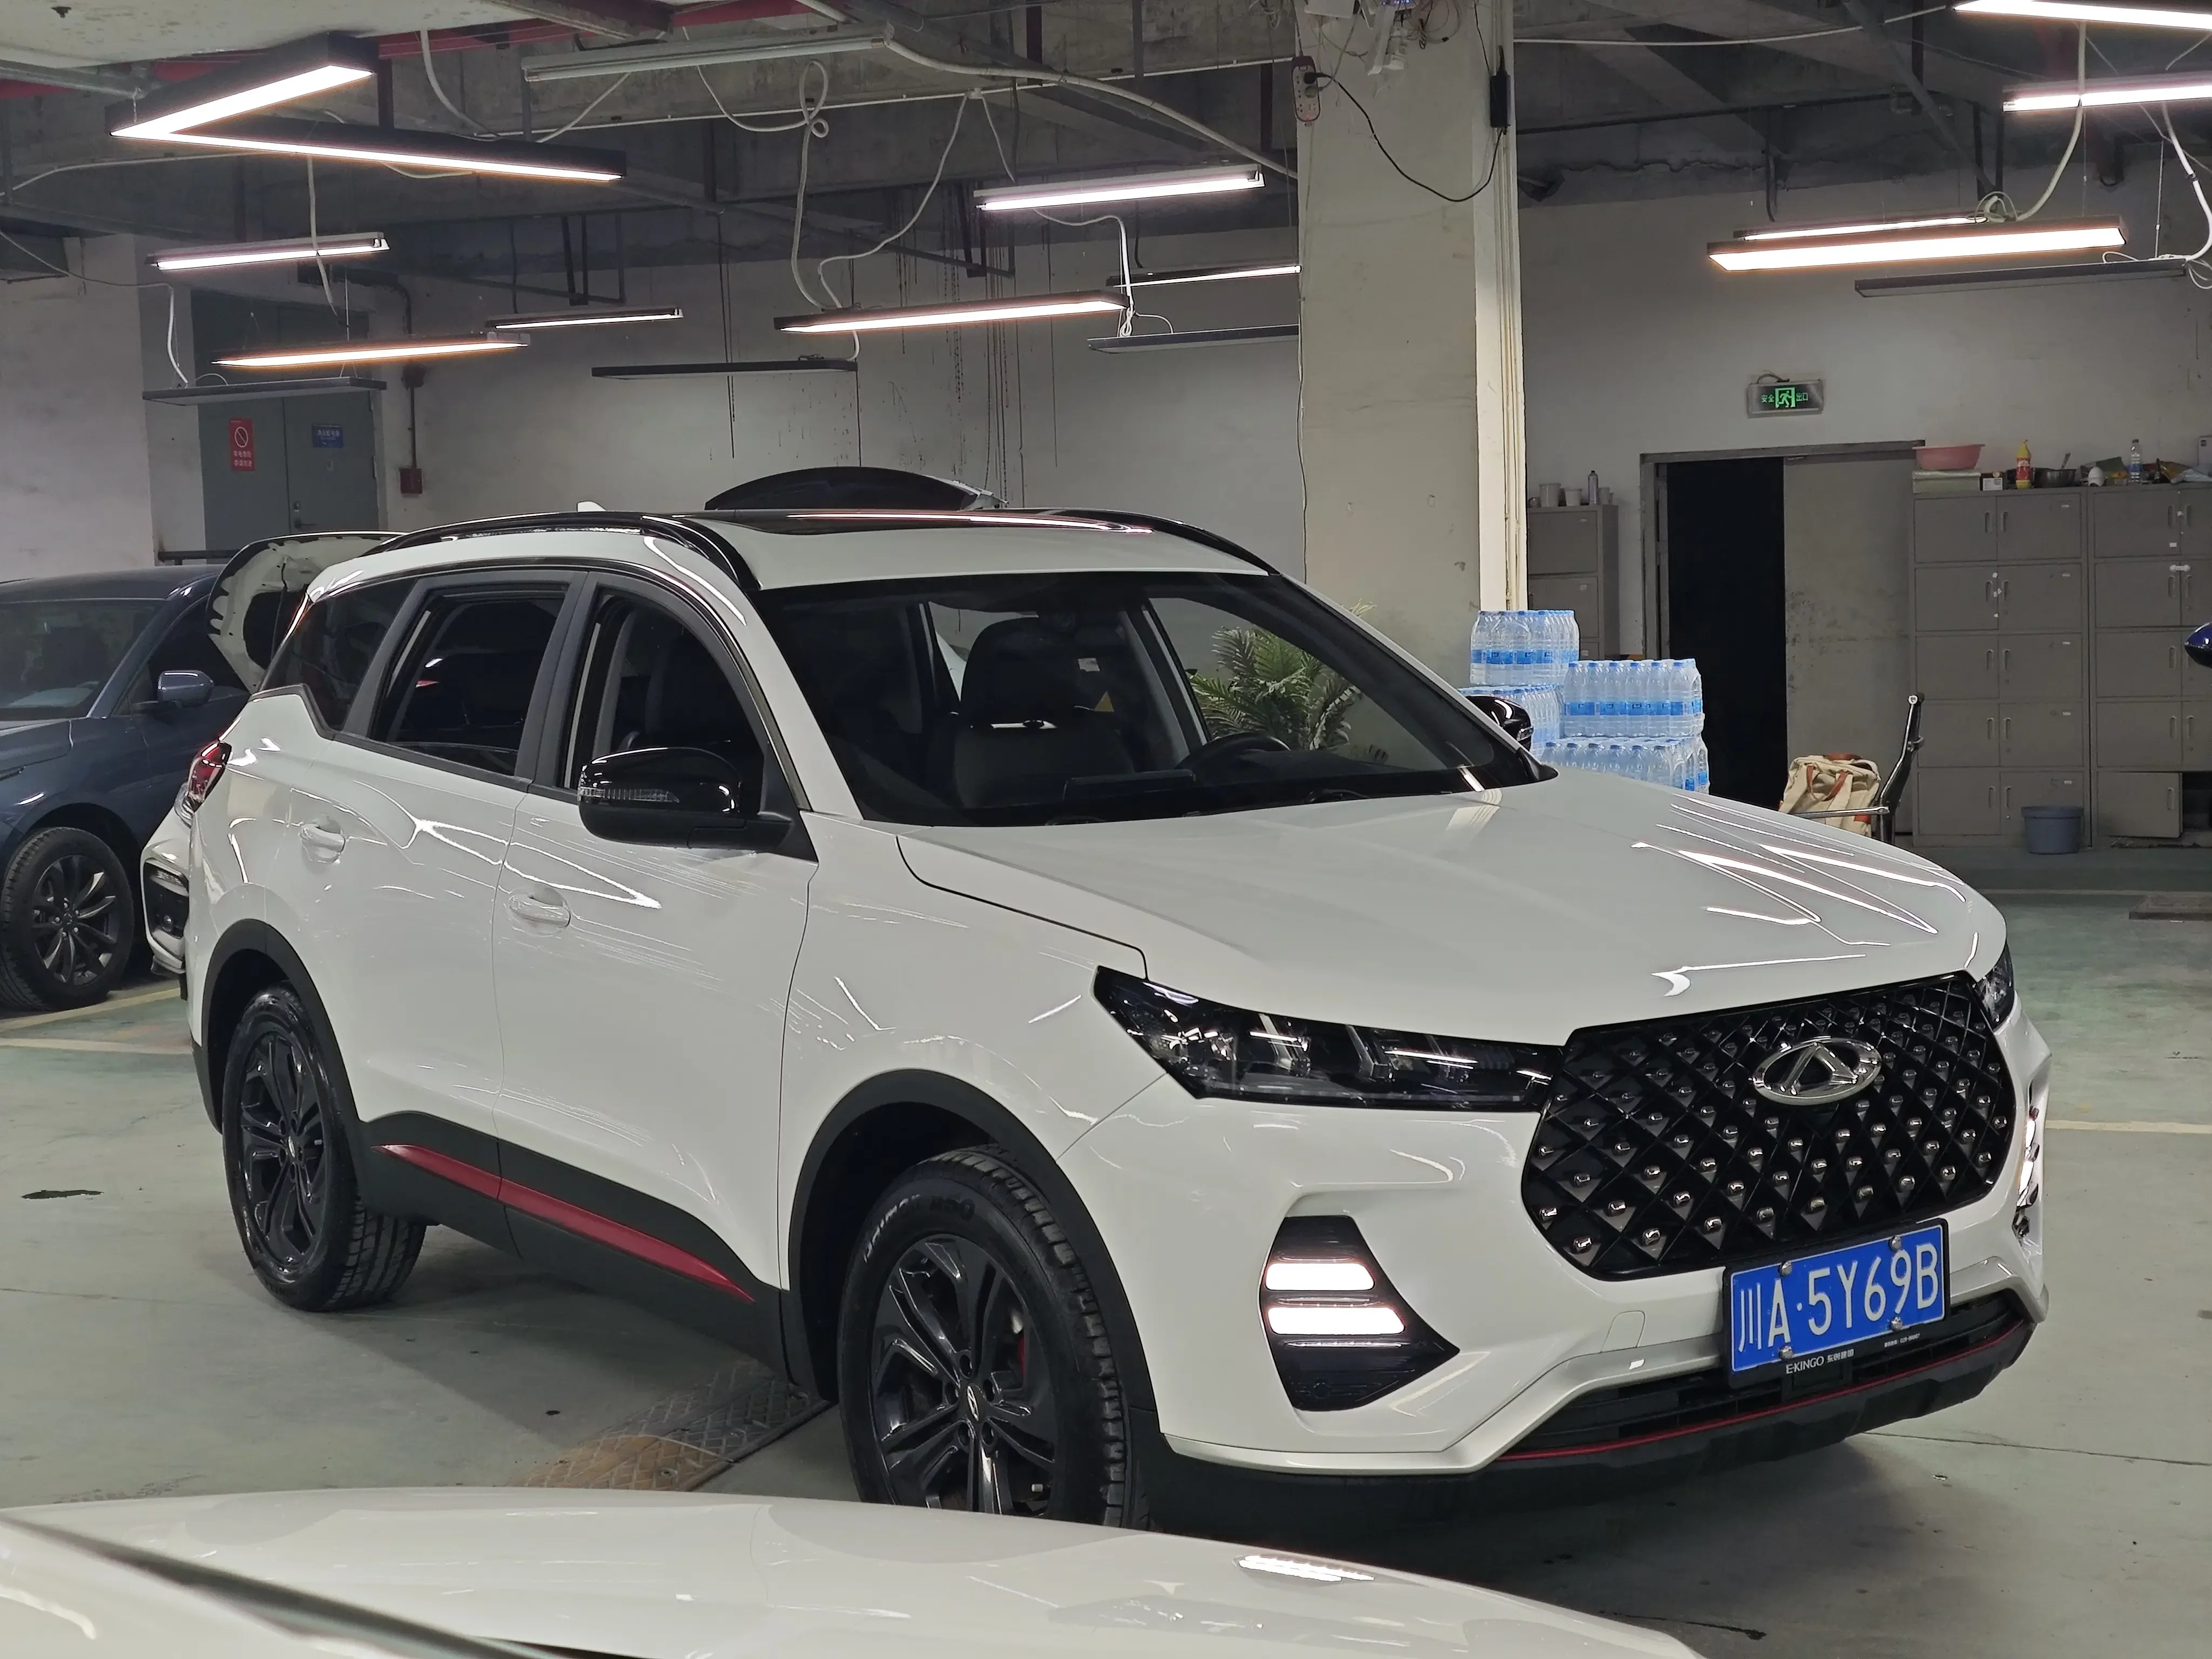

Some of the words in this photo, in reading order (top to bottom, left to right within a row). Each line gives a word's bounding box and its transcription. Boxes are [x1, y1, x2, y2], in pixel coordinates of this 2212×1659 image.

[1761, 394, 1775, 403] 安全
[1796, 392, 1809, 402] 出口
[1738, 1243, 1939, 1353] 川A·5Y69B
